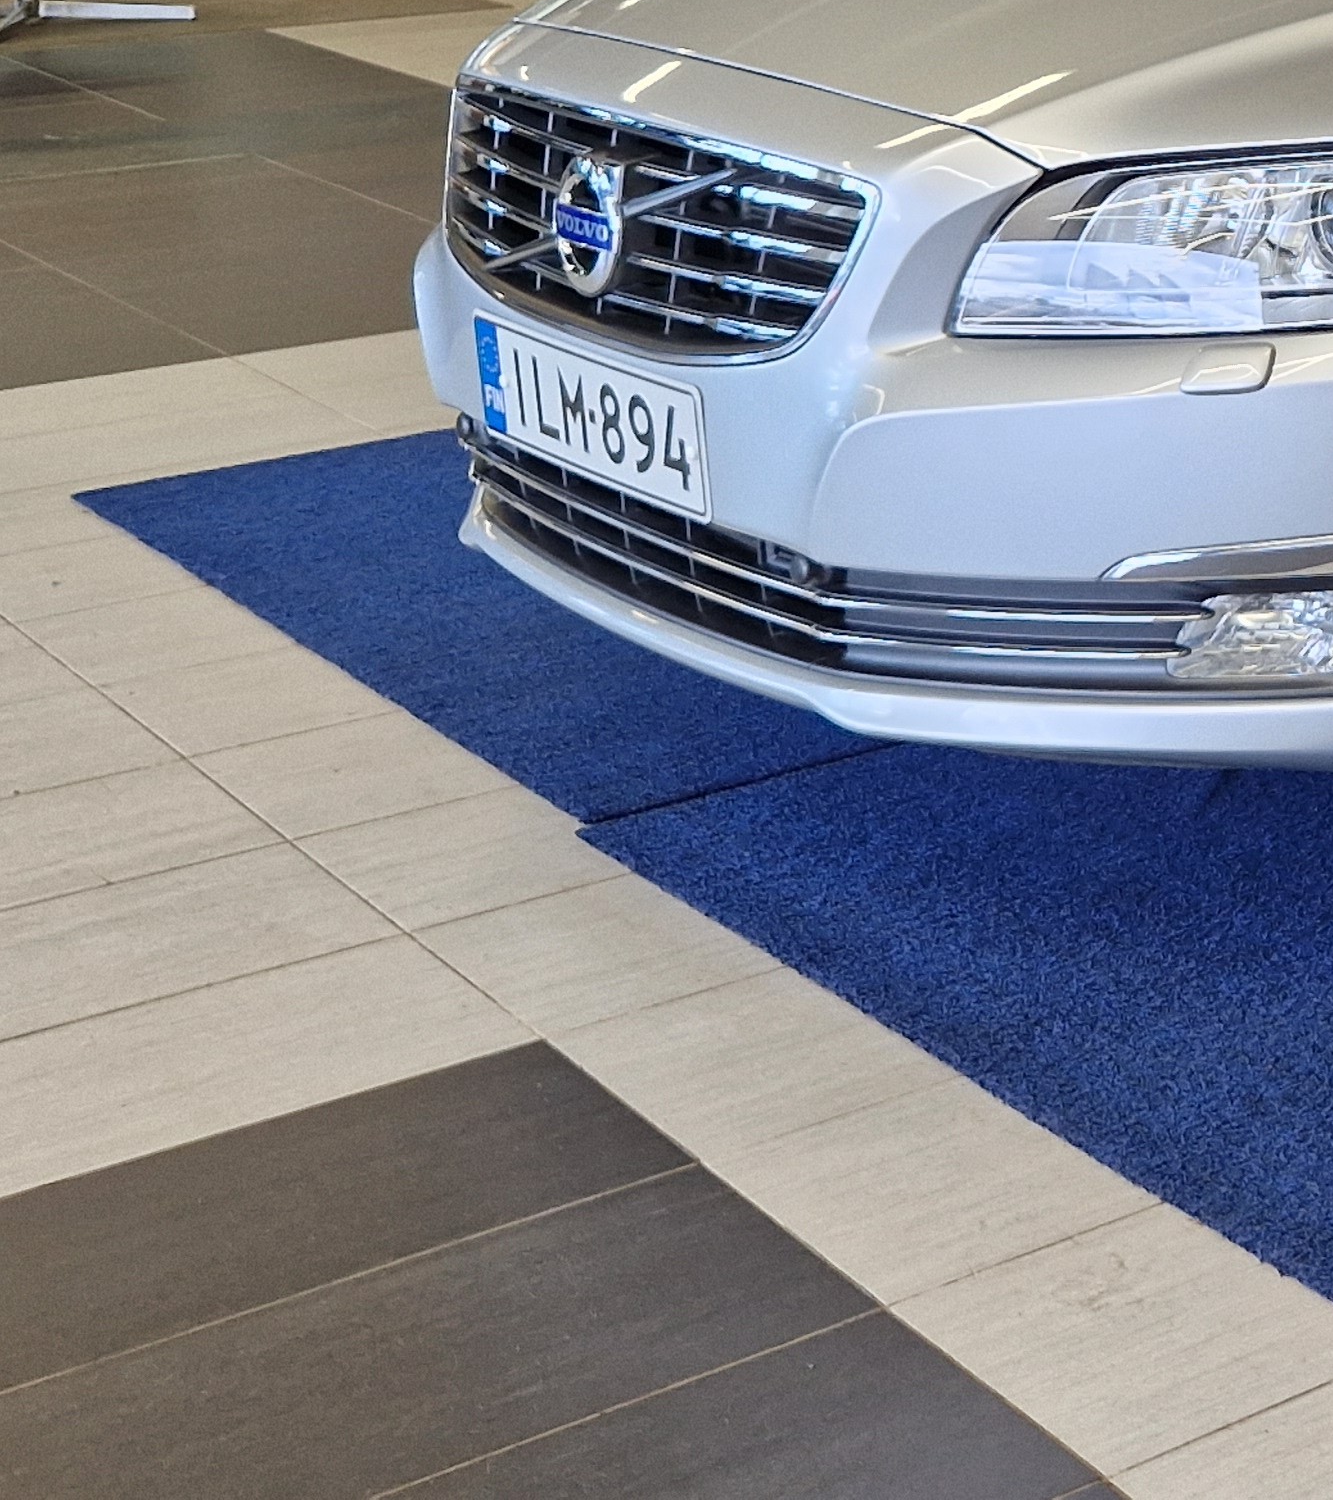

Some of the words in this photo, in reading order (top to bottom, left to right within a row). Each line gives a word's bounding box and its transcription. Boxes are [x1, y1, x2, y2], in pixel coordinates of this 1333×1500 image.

[557, 209, 609, 243] VOLVO
[484, 383, 506, 415] FIN
[513, 347, 691, 491] ILM-894
